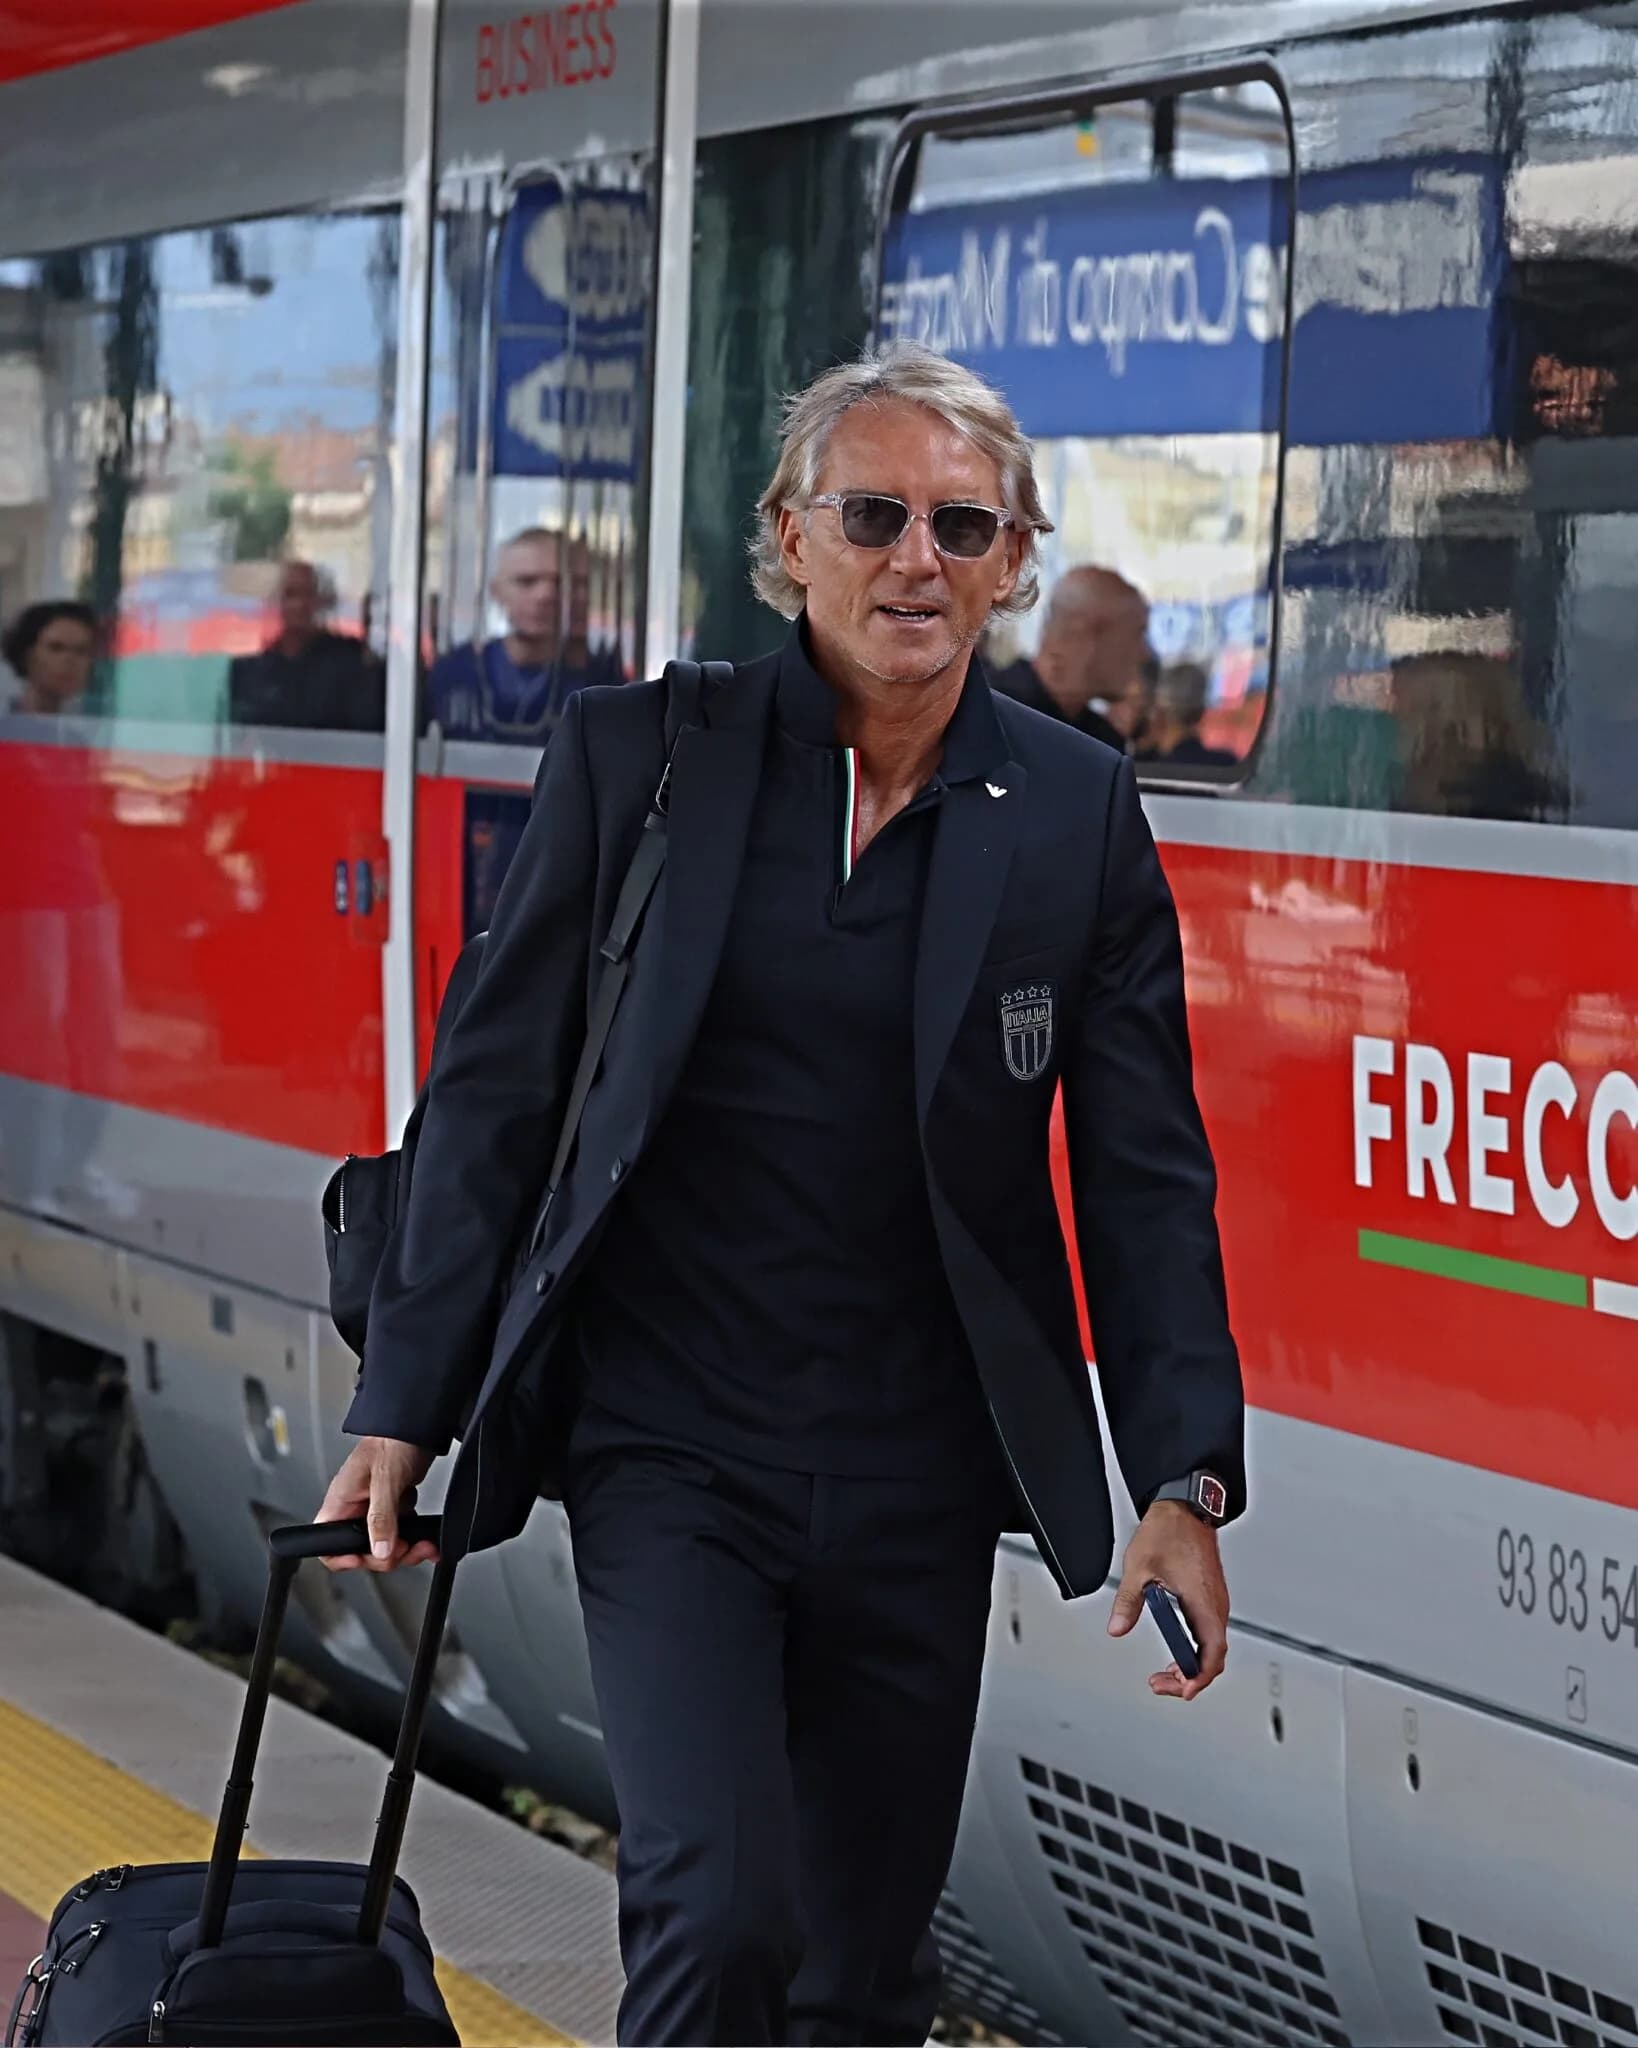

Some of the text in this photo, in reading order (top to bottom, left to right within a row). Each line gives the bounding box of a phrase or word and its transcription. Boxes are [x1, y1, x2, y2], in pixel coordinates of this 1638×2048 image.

[477, 0, 618, 104] BUSINESS
[1006, 1005, 1048, 1028] ITALIA
[1353, 1034, 1638, 1241] FRECC
[1498, 1527, 1638, 1649] 93 83 54
